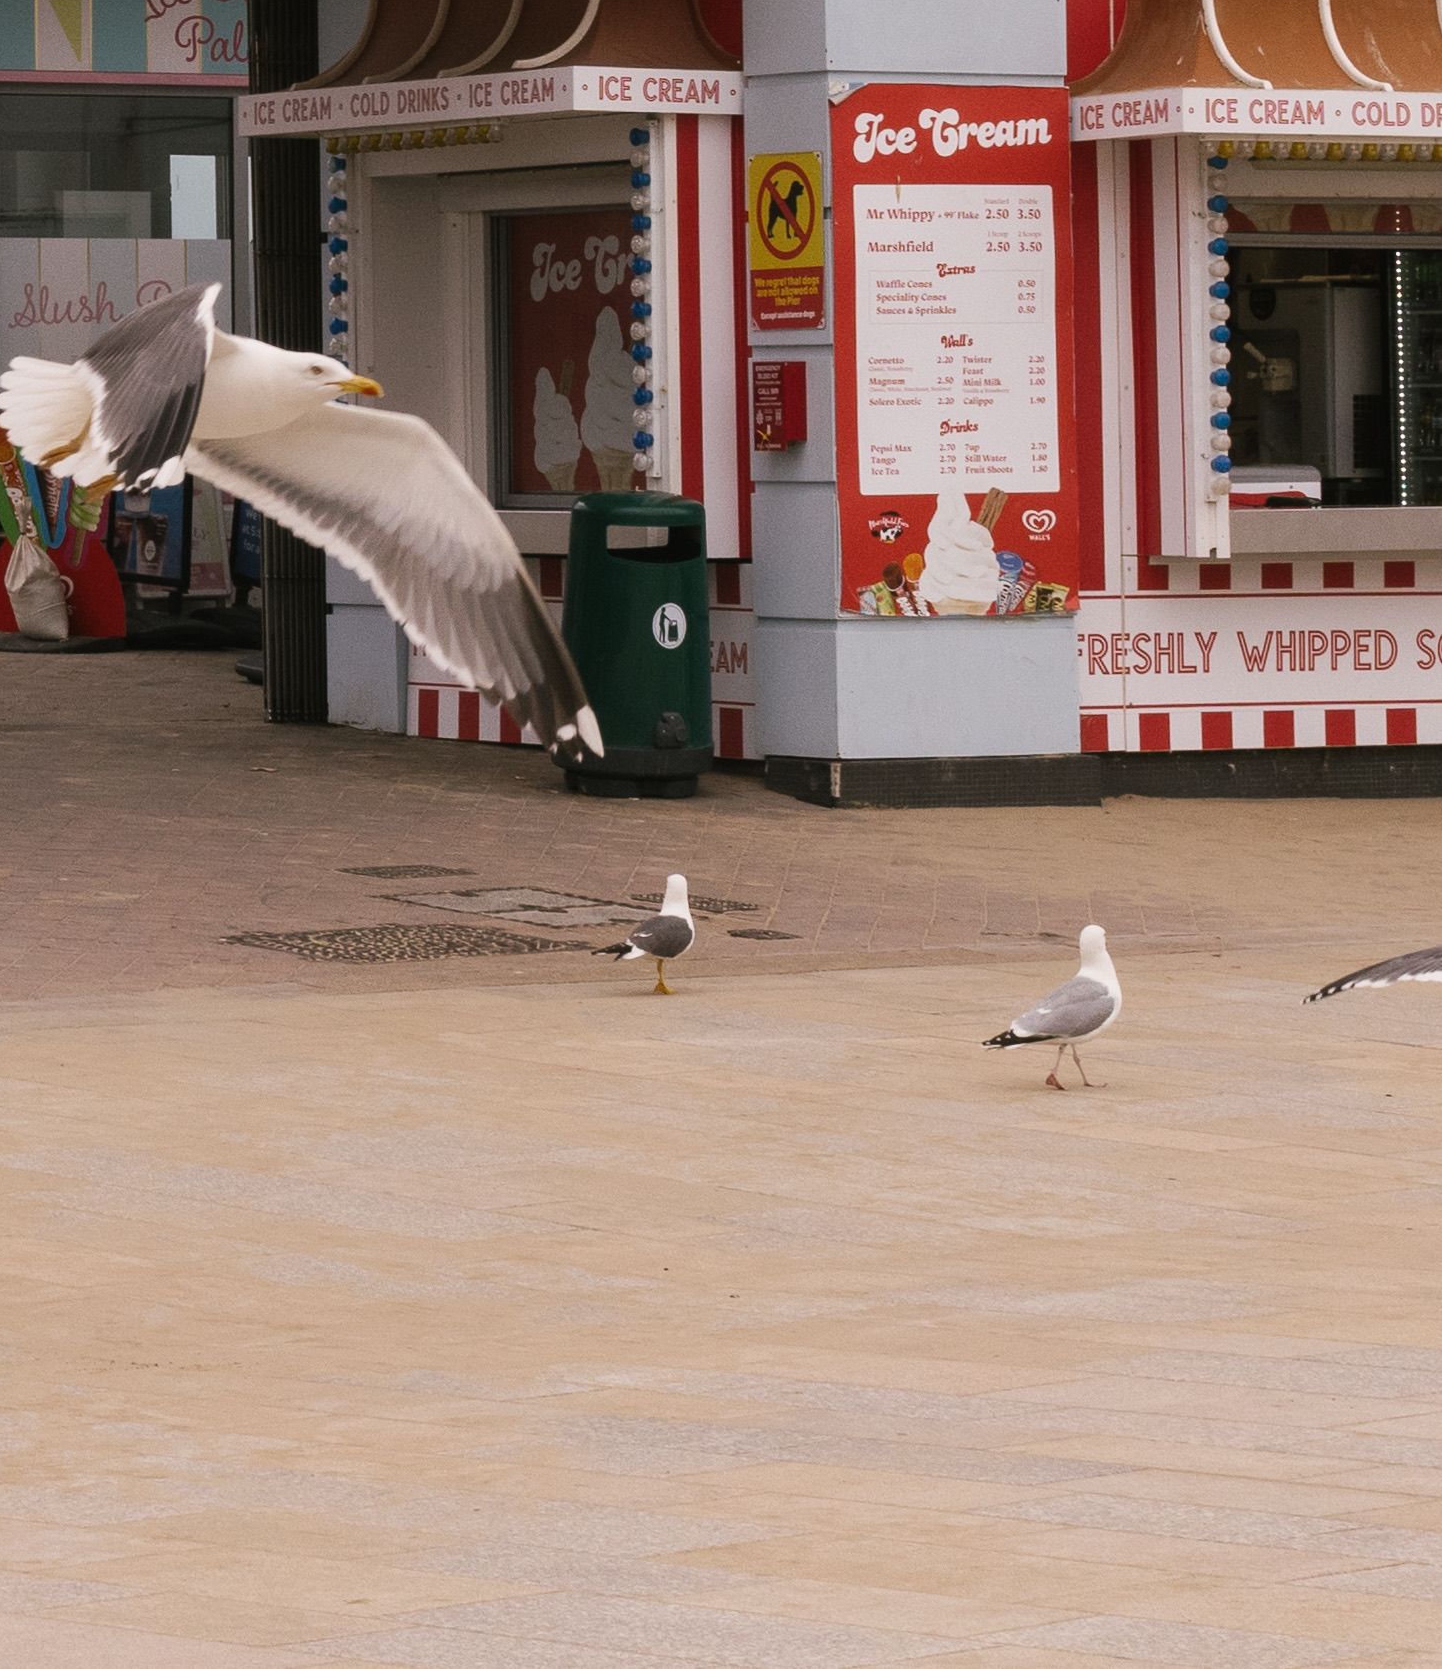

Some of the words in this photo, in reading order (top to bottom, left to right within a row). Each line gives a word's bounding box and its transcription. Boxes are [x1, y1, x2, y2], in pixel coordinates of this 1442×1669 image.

[254, 100, 275, 125] ICE
[283, 96, 332, 123] CREAM
[350, 92, 390, 117] COLD
[396, 87, 449, 113] DRINKS
[469, 84, 491, 108] ICE
[500, 78, 555, 105] CREAM
[598, 76, 632, 102] ICE
[643, 77, 720, 105] CREAM
[1079, 105, 1104, 130] ICE
[1113, 98, 1169, 128] CREAM
[1205, 99, 1238, 123] ICE
[1249, 99, 1325, 125] CREAM
[1352, 101, 1411, 126] COLD
[853, 112, 916, 164] Ice
[919, 107, 1052, 156] Cream
[866, 209, 884, 220] Mr
[888, 208, 935, 222] Whippy
[985, 209, 1009, 220] 2.50
[1017, 209, 1041, 220] 3.50
[868, 241, 934, 253] Marshfield
[986, 242, 1010, 252] 2.50
[1018, 242, 1042, 252] 3.50
[936, 263, 976, 278] Extras
[9, 281, 124, 328] Slush
[1236, 630, 1398, 672] WHIPPED
